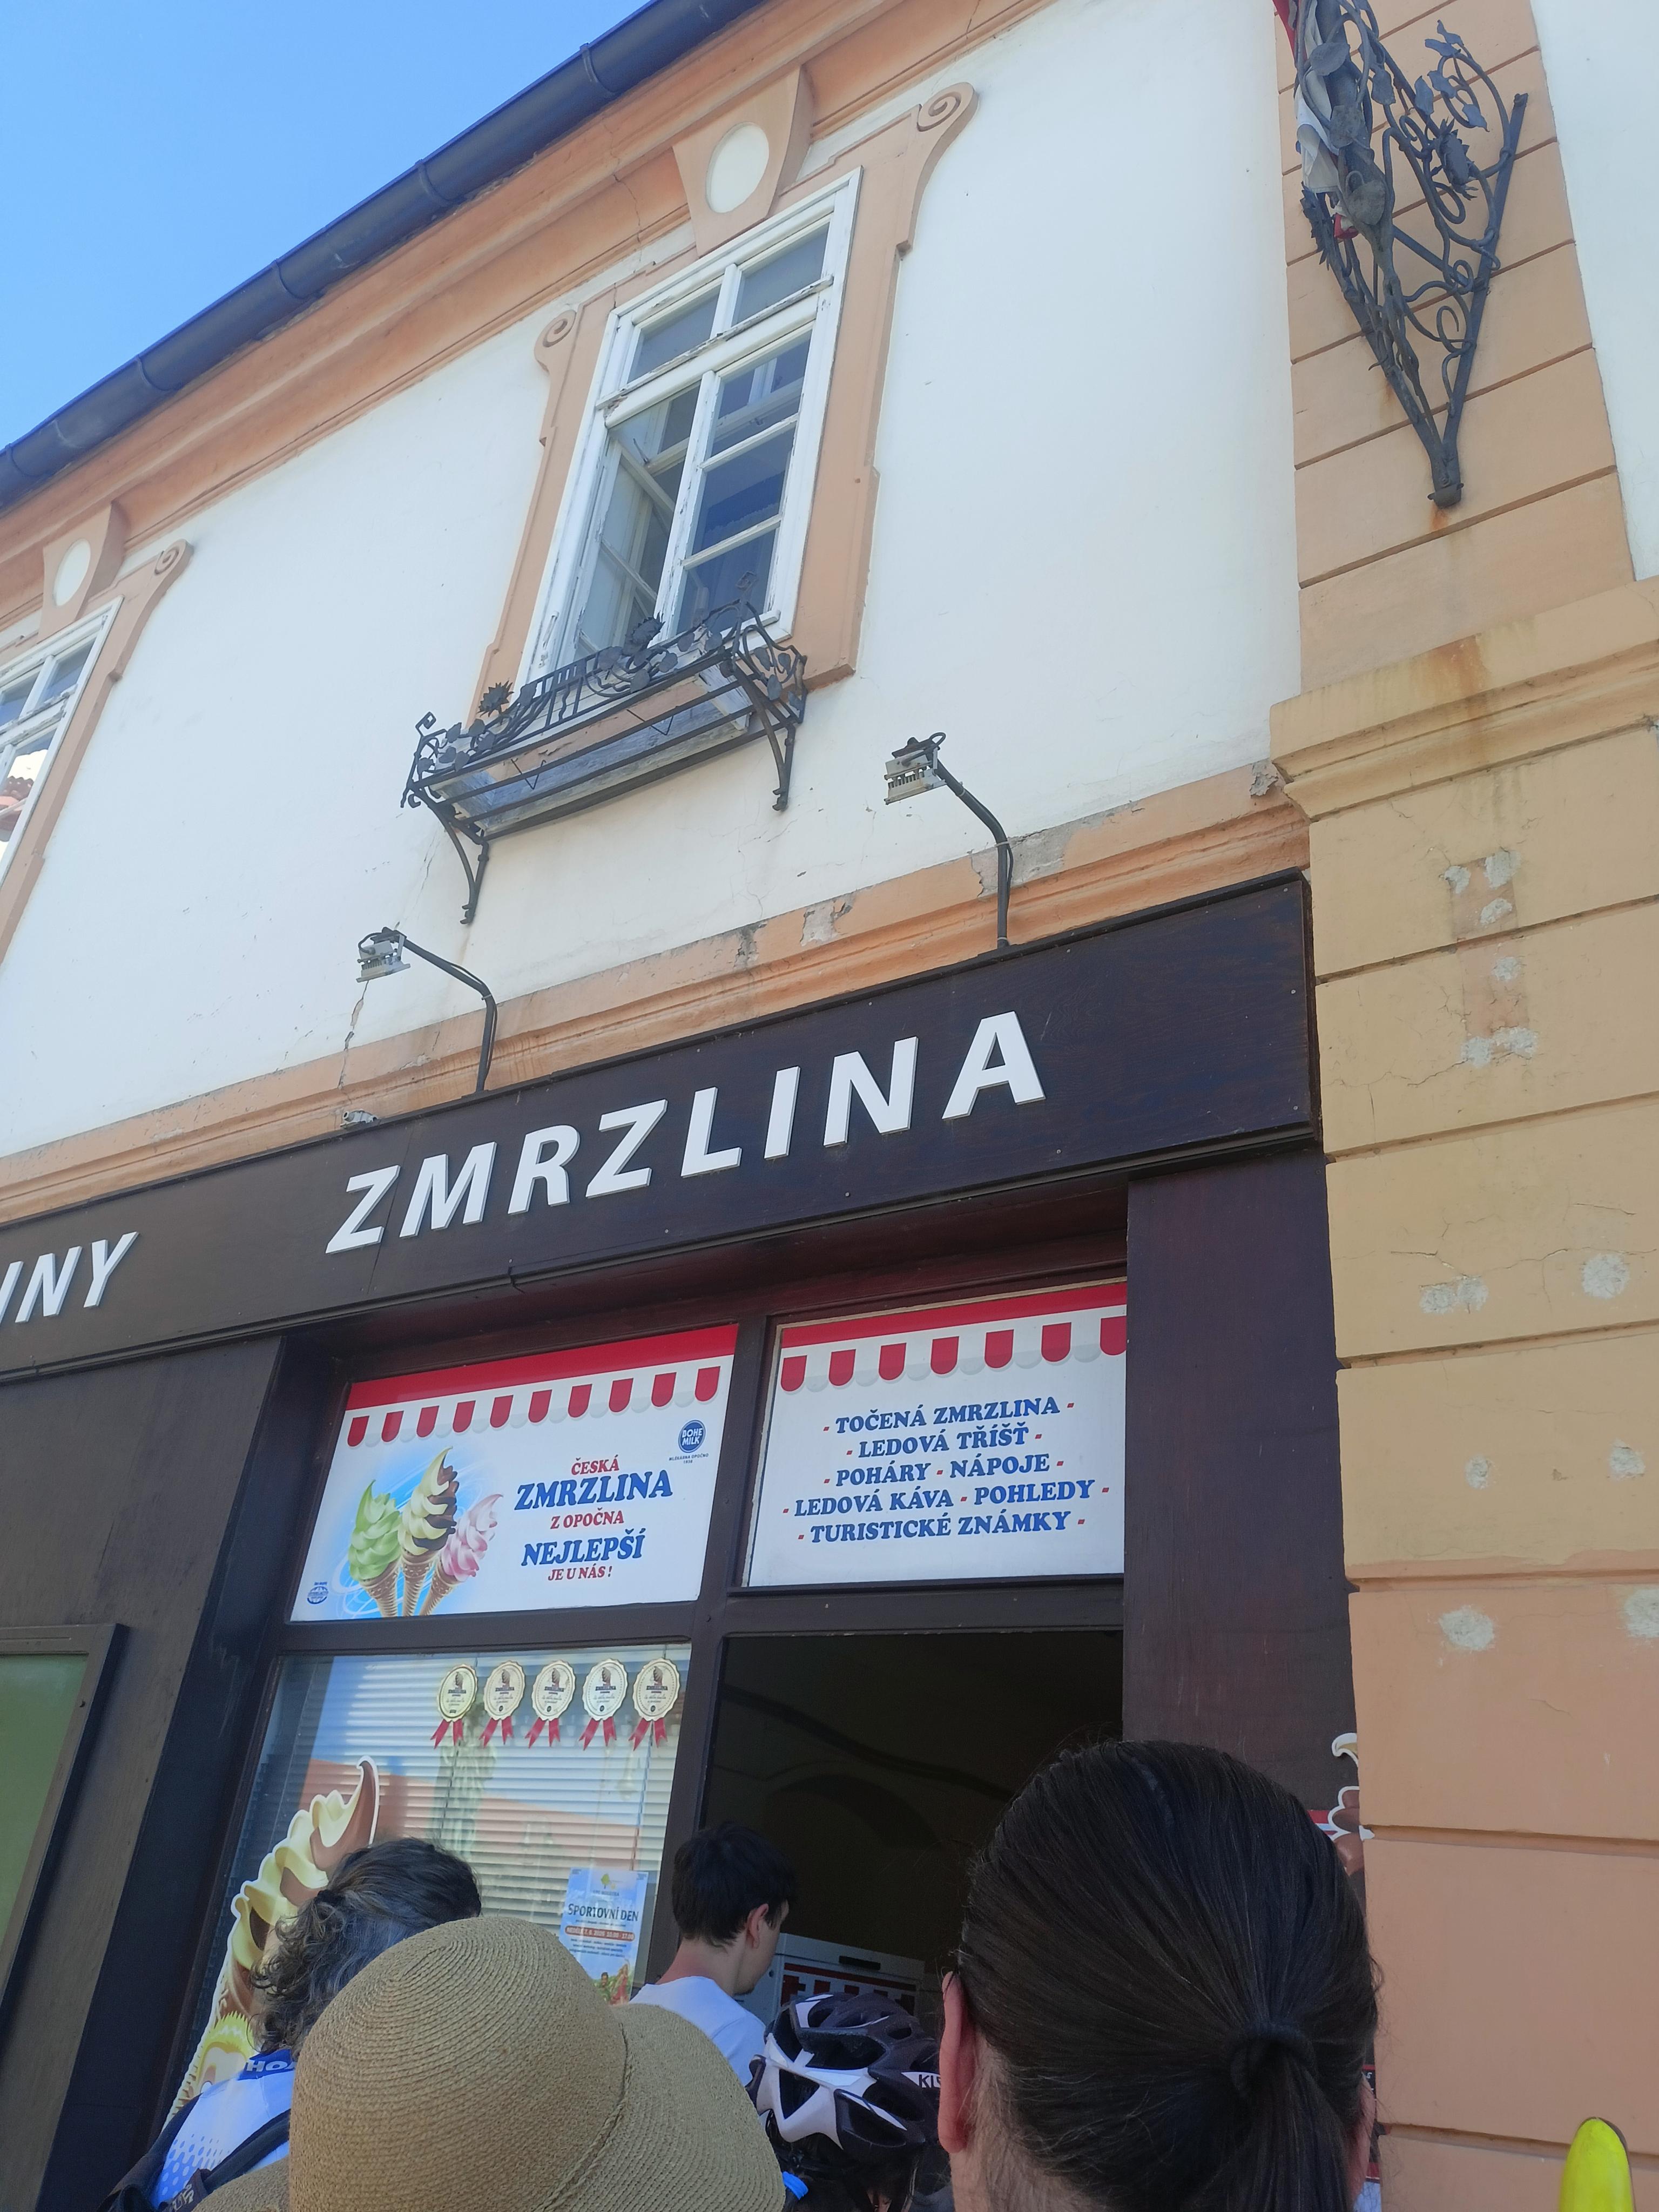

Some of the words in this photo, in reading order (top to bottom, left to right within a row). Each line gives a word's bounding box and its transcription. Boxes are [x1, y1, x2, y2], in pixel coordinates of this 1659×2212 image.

[326, 1011, 1046, 1254] ZMRZLINA
[835, 1404, 927, 1433] TOČENÁ
[934, 1397, 1060, 1424] ZMRZLINA
[682, 1437, 700, 1446] MILK
[858, 1429, 949, 1458] LEDOVÁ
[956, 1421, 1029, 1449] TŘÍŠŤ
[571, 1454, 619, 1475] ČESKÁ
[836, 1460, 931, 1486] POHÁRY
[950, 1453, 1050, 1478] NÁPOJE
[514, 1469, 673, 1510] ZMRZLINA
[794, 1489, 883, 1516] LEDOVÁ
[889, 1486, 954, 1510] KÁVA
[974, 1480, 1095, 1505] POHLEDY
[550, 1516, 561, 1529] Z
[563, 1507, 624, 1528] OPOČNA
[811, 1512, 951, 1542] TURISTICKÉ
[958, 1509, 1071, 1535] ZNÁMKY
[521, 1528, 646, 1566] NEJLEPŠÍ
[548, 1569, 564, 1581] JE
[567, 1568, 576, 1579] U
[621, 1910, 639, 1921] DEN
